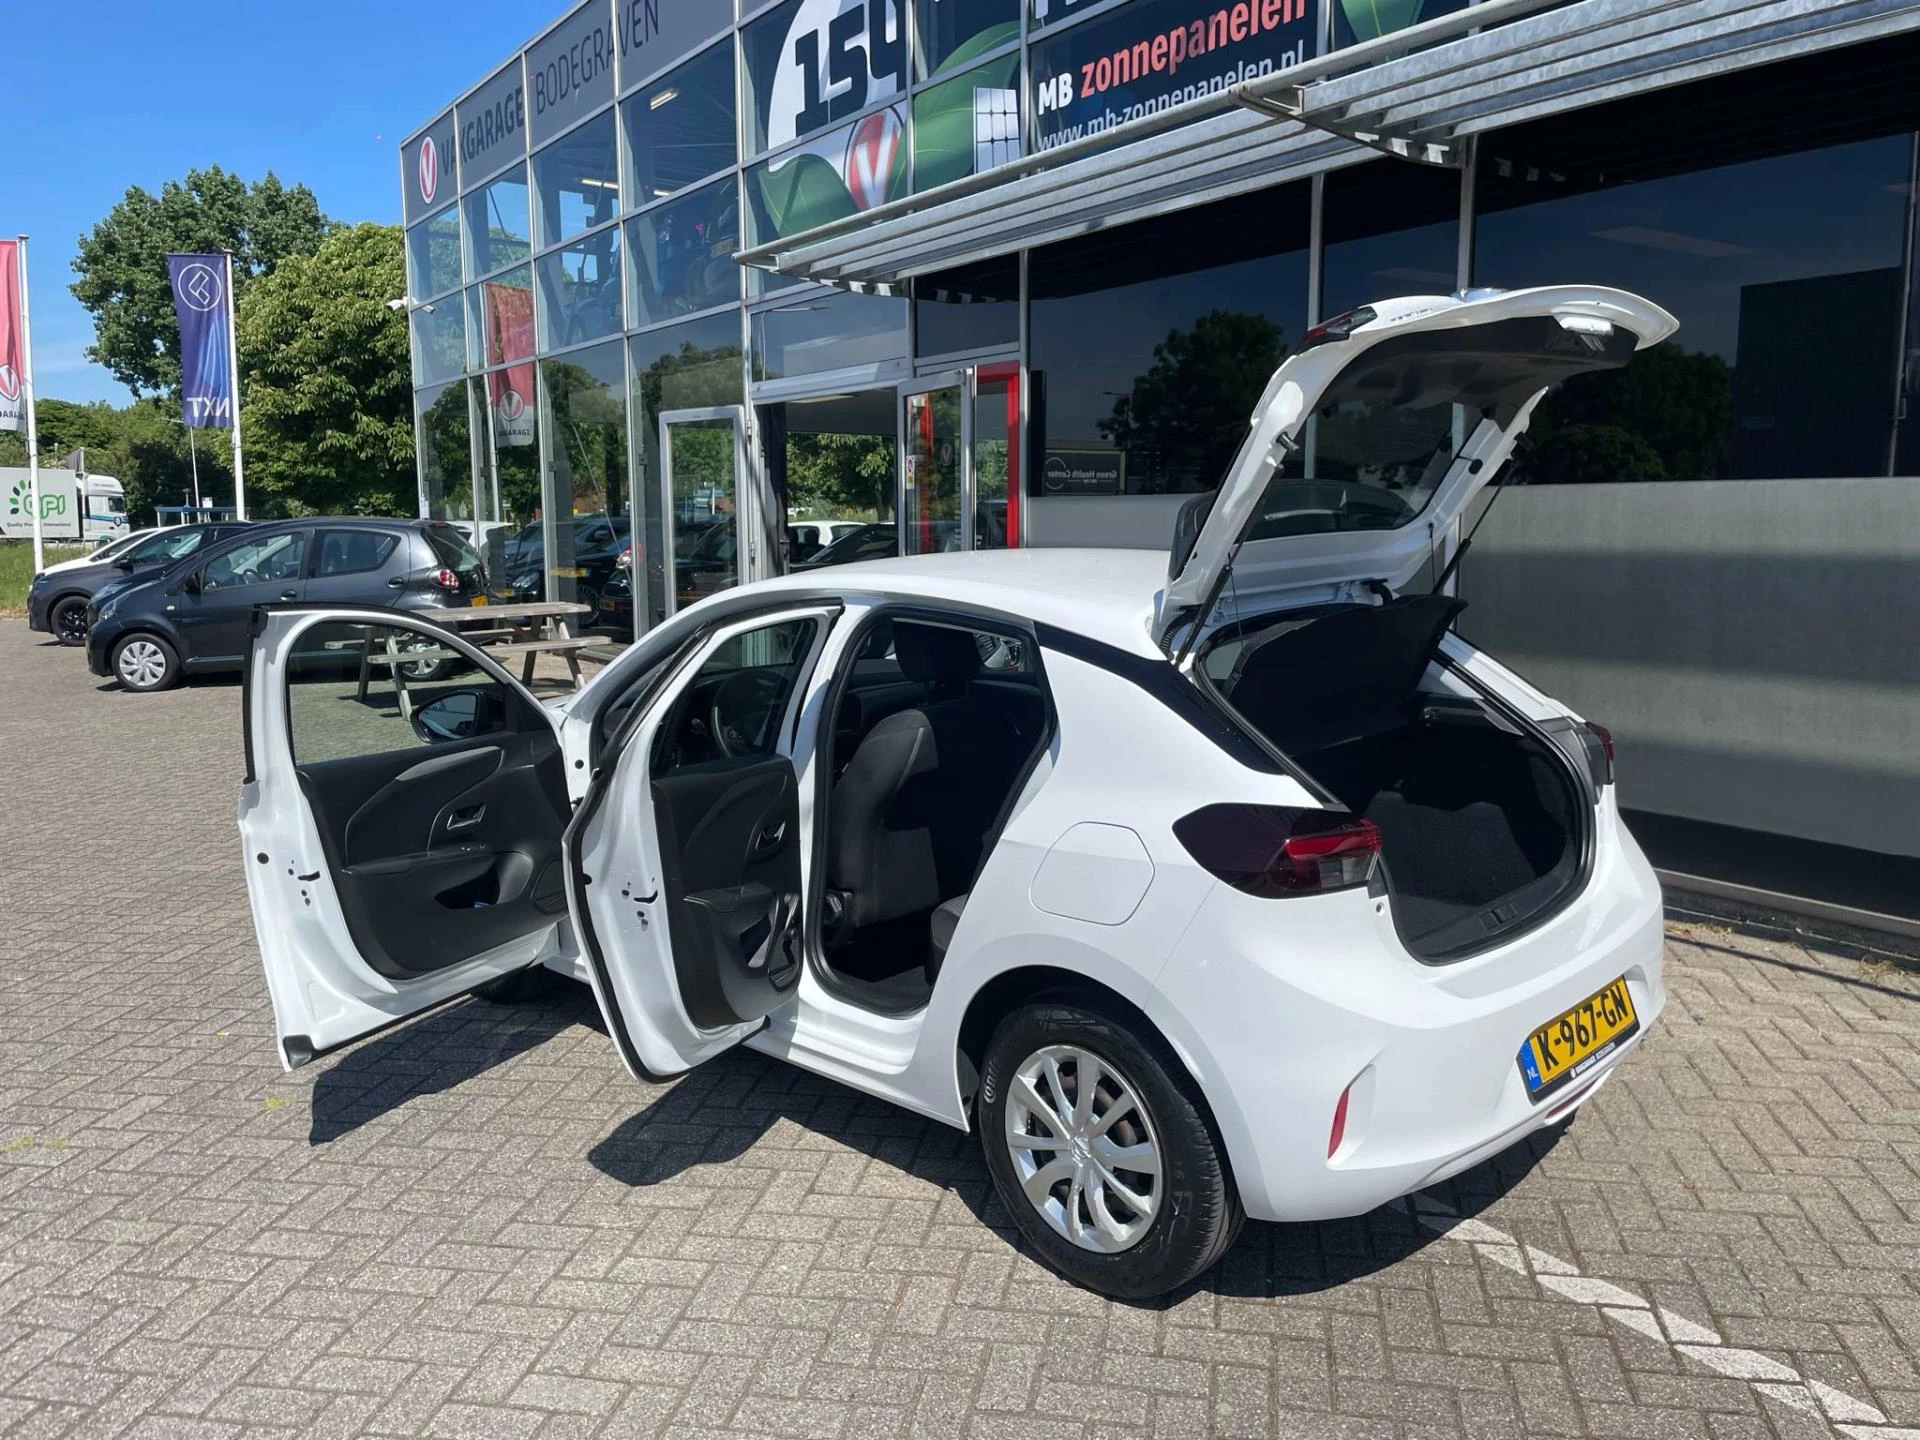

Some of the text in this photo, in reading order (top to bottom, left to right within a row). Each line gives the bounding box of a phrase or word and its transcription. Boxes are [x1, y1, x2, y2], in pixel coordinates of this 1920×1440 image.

[441, 84, 525, 177] VAKGARAGE
[535, 0, 659, 116] BODEGRAVEN
[1038, 0, 1305, 116] MB zonnepanelen
[1039, 39, 1304, 151] www.mb-zonnepanelen.nl
[1527, 1065, 1539, 1081] NL
[1536, 984, 1629, 1072] K-967-GN
